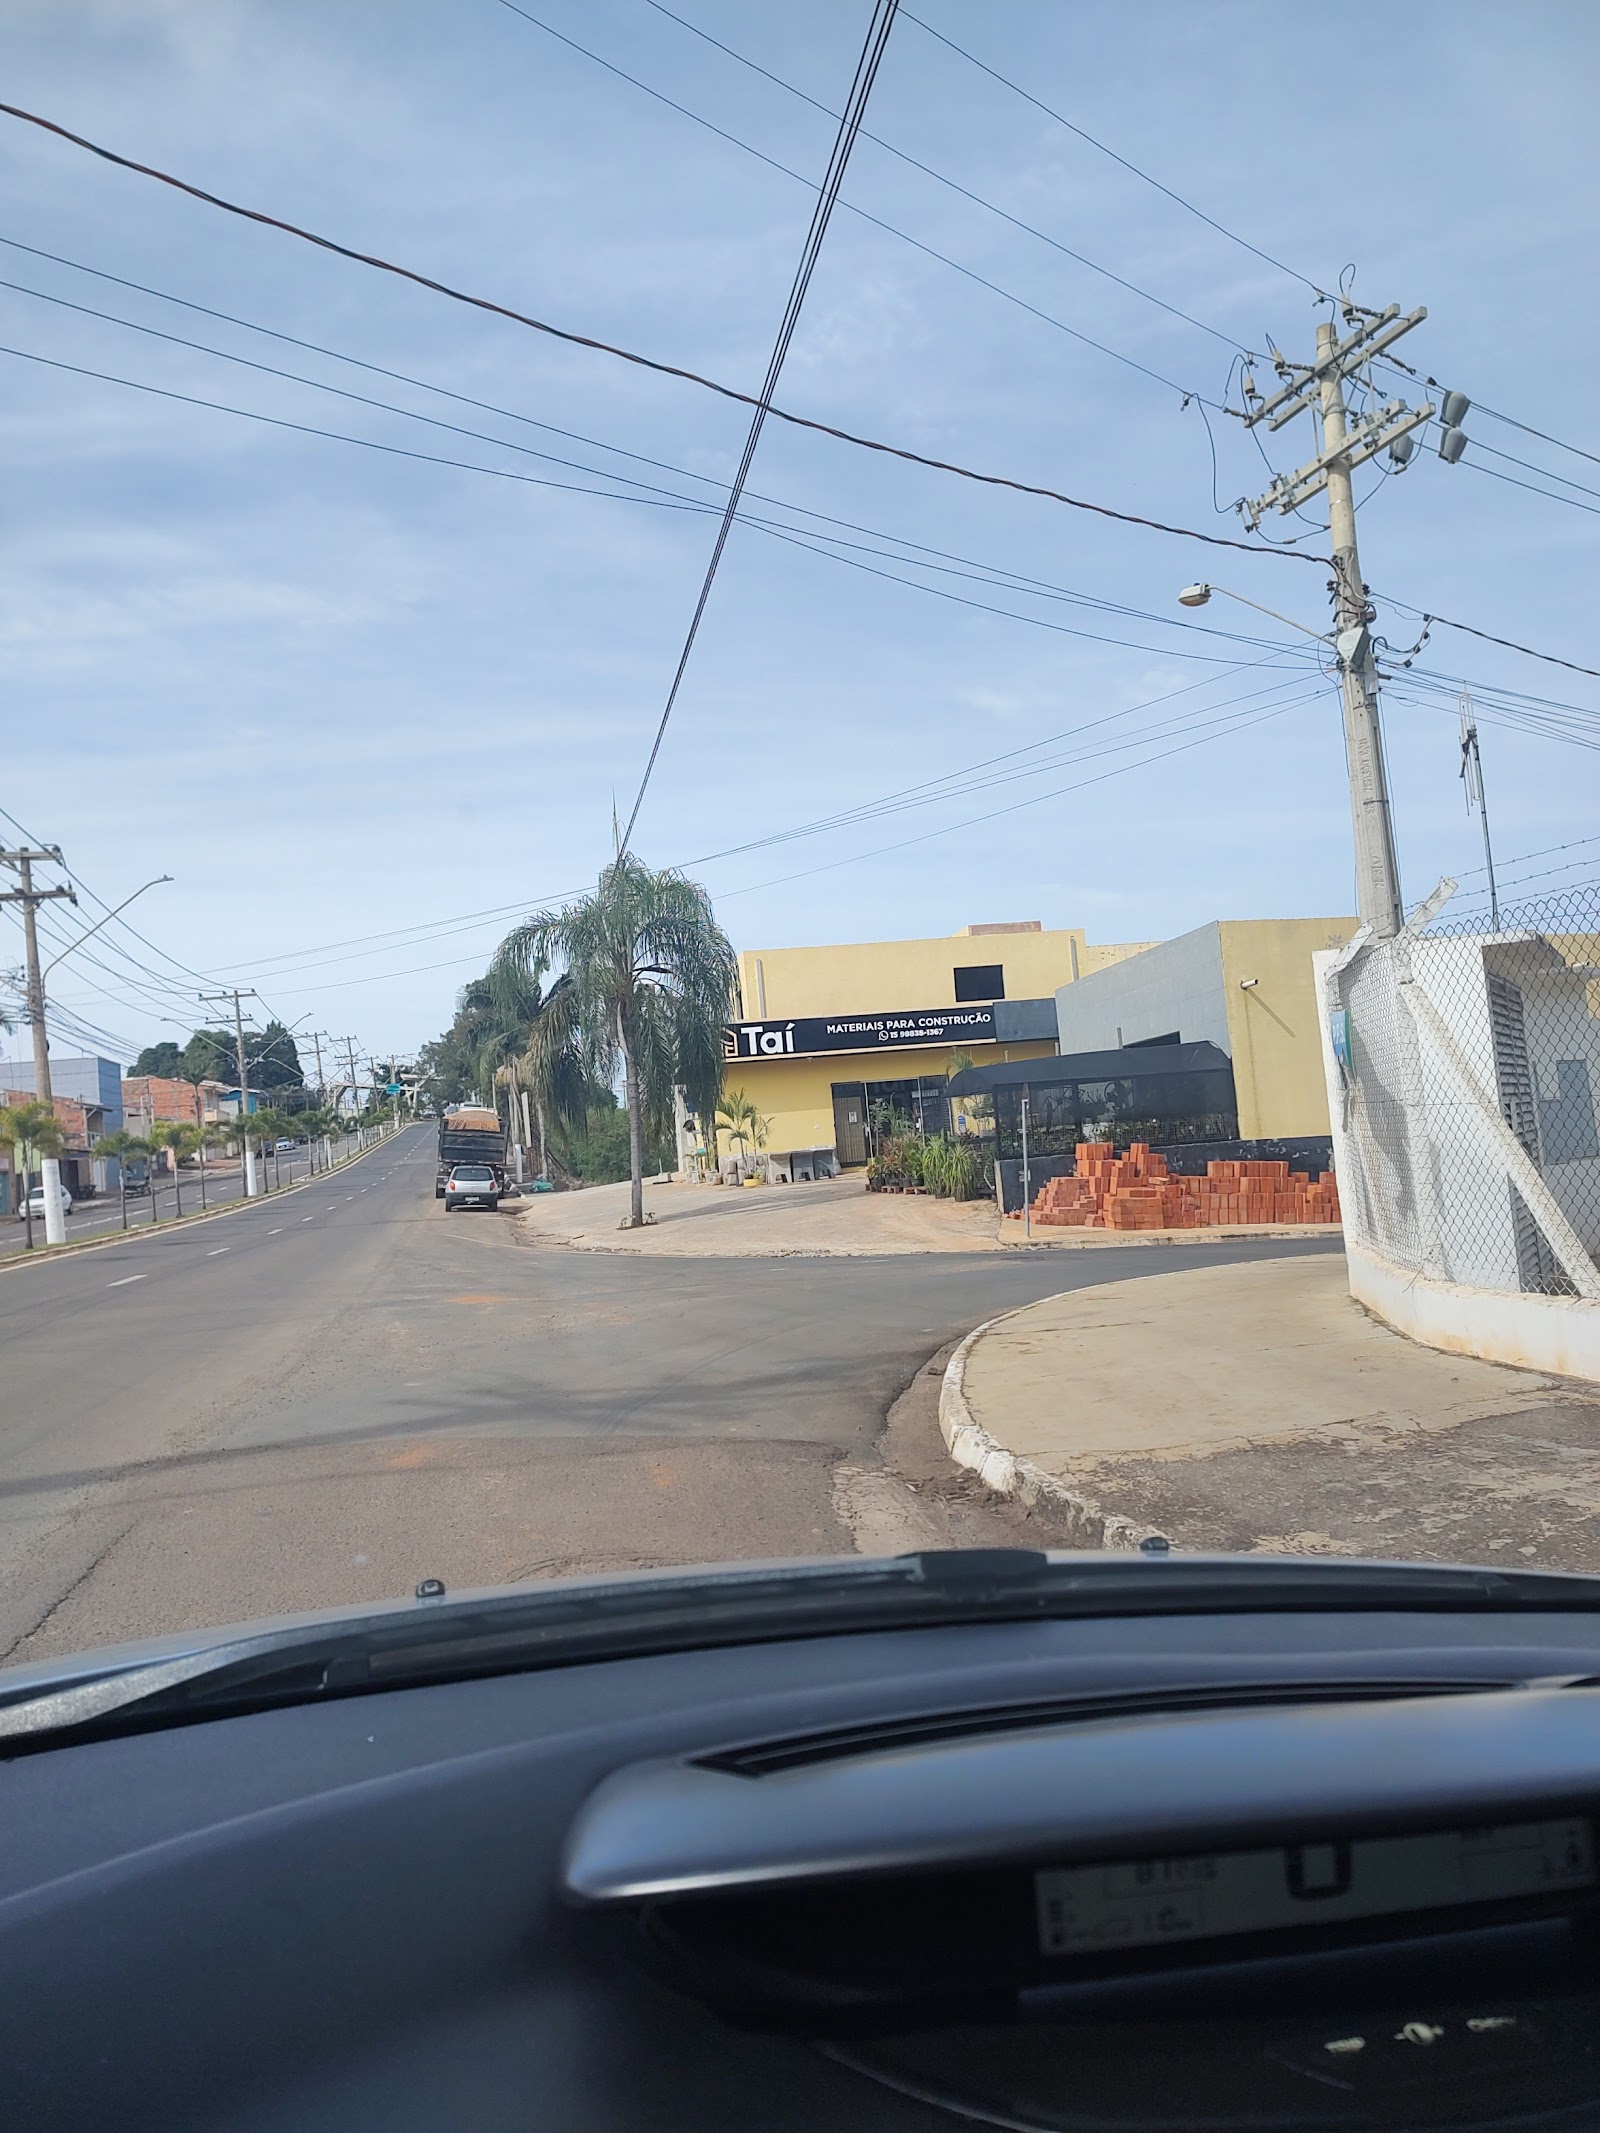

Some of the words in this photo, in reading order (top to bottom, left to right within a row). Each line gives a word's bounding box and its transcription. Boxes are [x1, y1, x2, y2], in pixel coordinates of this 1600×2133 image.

[827, 1021, 884, 1034] MATERIAIS
[887, 1018, 915, 1030] PARA
[918, 1012, 991, 1027] CONSTRUÇÃO
[741, 1023, 795, 1055] Taí
[890, 1031, 898, 1039] 15
